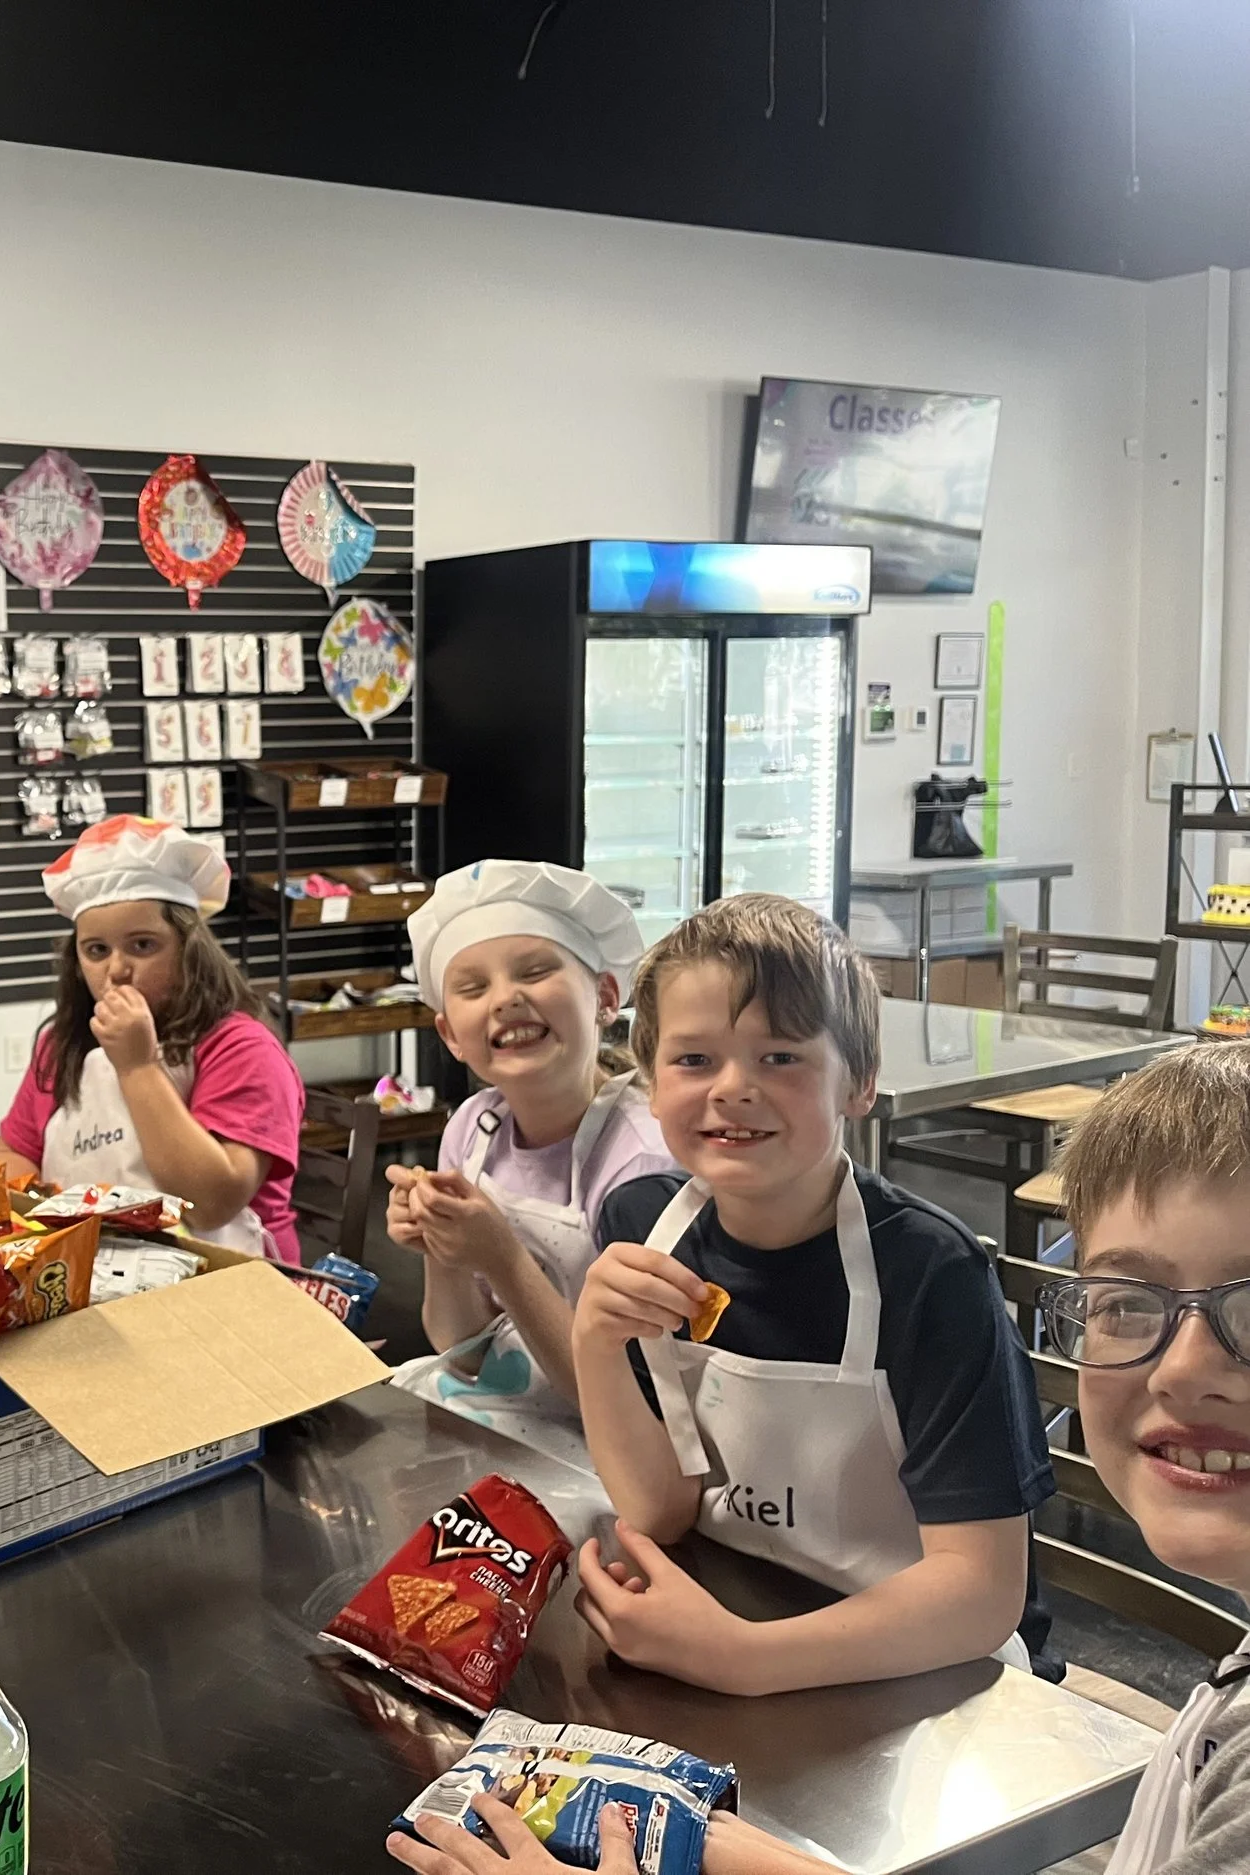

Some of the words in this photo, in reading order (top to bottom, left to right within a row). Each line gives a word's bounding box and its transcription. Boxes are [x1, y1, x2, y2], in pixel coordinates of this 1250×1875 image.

[829, 394, 933, 434] Classe
[199, 649, 215, 681] 2
[72, 1124, 123, 1158] Andrea
[724, 1484, 794, 1528] Kiel
[432, 1507, 532, 1574] oritos
[472, 1652, 495, 1672] 150
